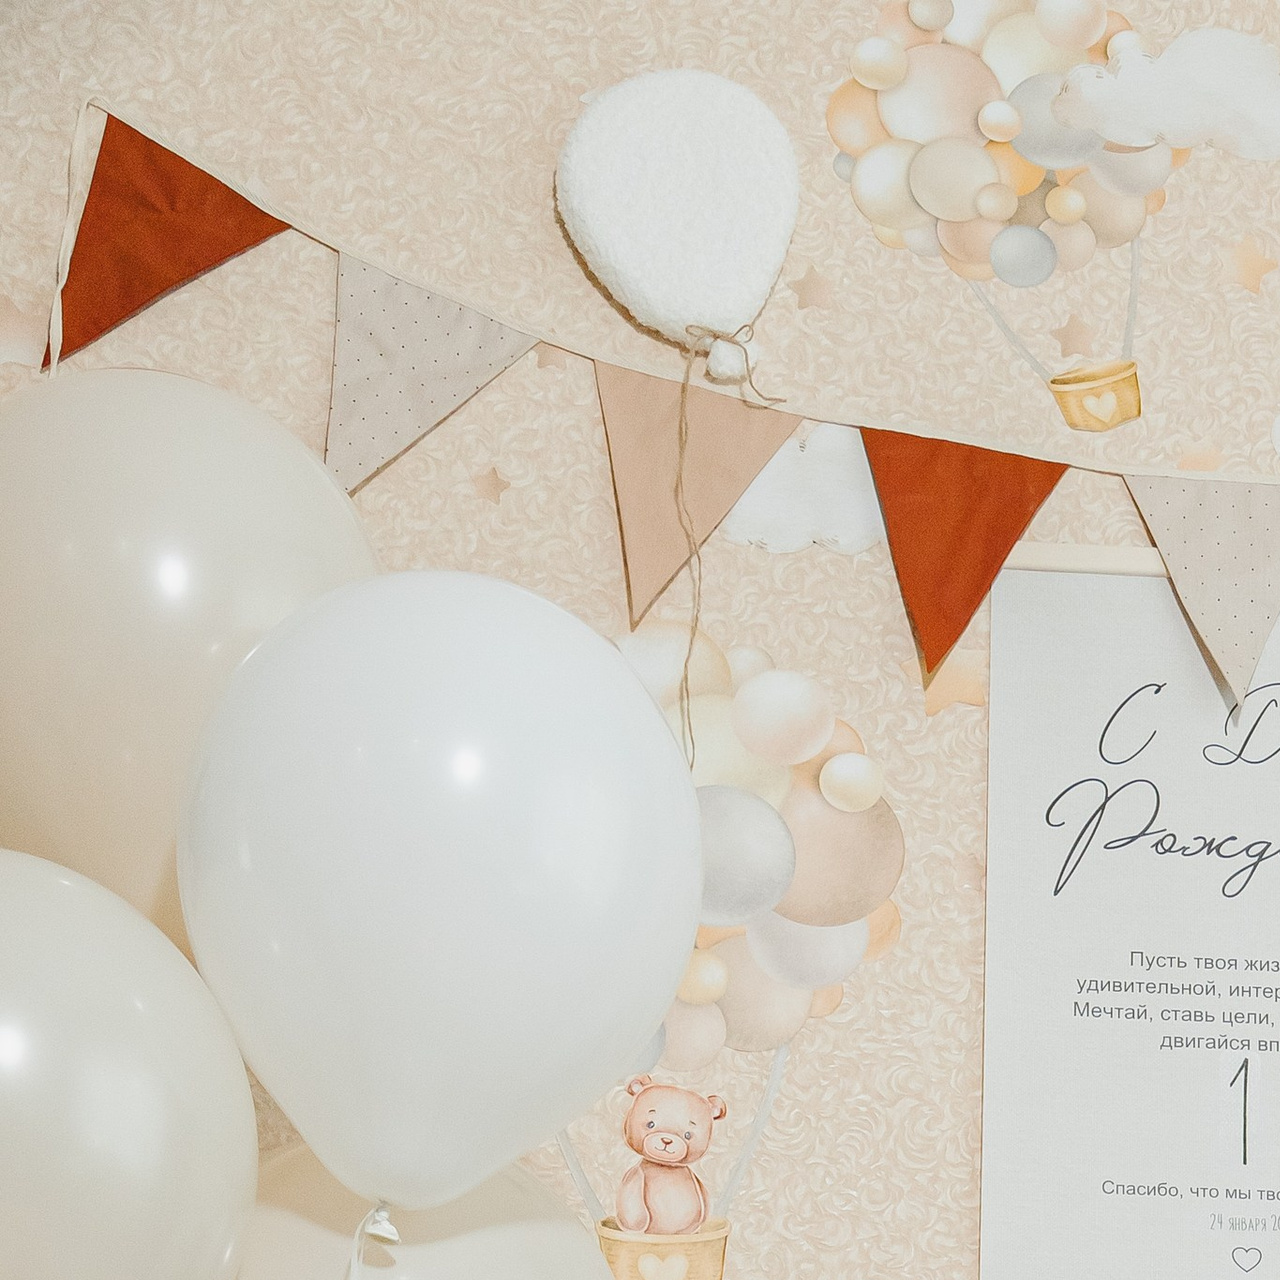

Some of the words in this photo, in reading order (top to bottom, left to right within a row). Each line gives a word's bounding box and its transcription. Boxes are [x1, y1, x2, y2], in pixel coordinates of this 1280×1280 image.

[1098, 683, 1168, 764] С
[1130, 952, 1188, 971] Пусть
[1193, 958, 1238, 969] твоя
[1076, 979, 1221, 998] удивительной,
[1073, 1002, 1153, 1022] Мечтай,
[1160, 1009, 1216, 1022] ставь
[1222, 1012, 1275, 1027] цели,
[1159, 1035, 1251, 1050] двигайся
[1229, 1058, 1249, 1165] 1
[1102, 1181, 1183, 1198] Спасибо,
[1189, 1188, 1220, 1198] что
[1225, 1189, 1251, 1199] мы
[1208, 1213, 1224, 1231] 24
